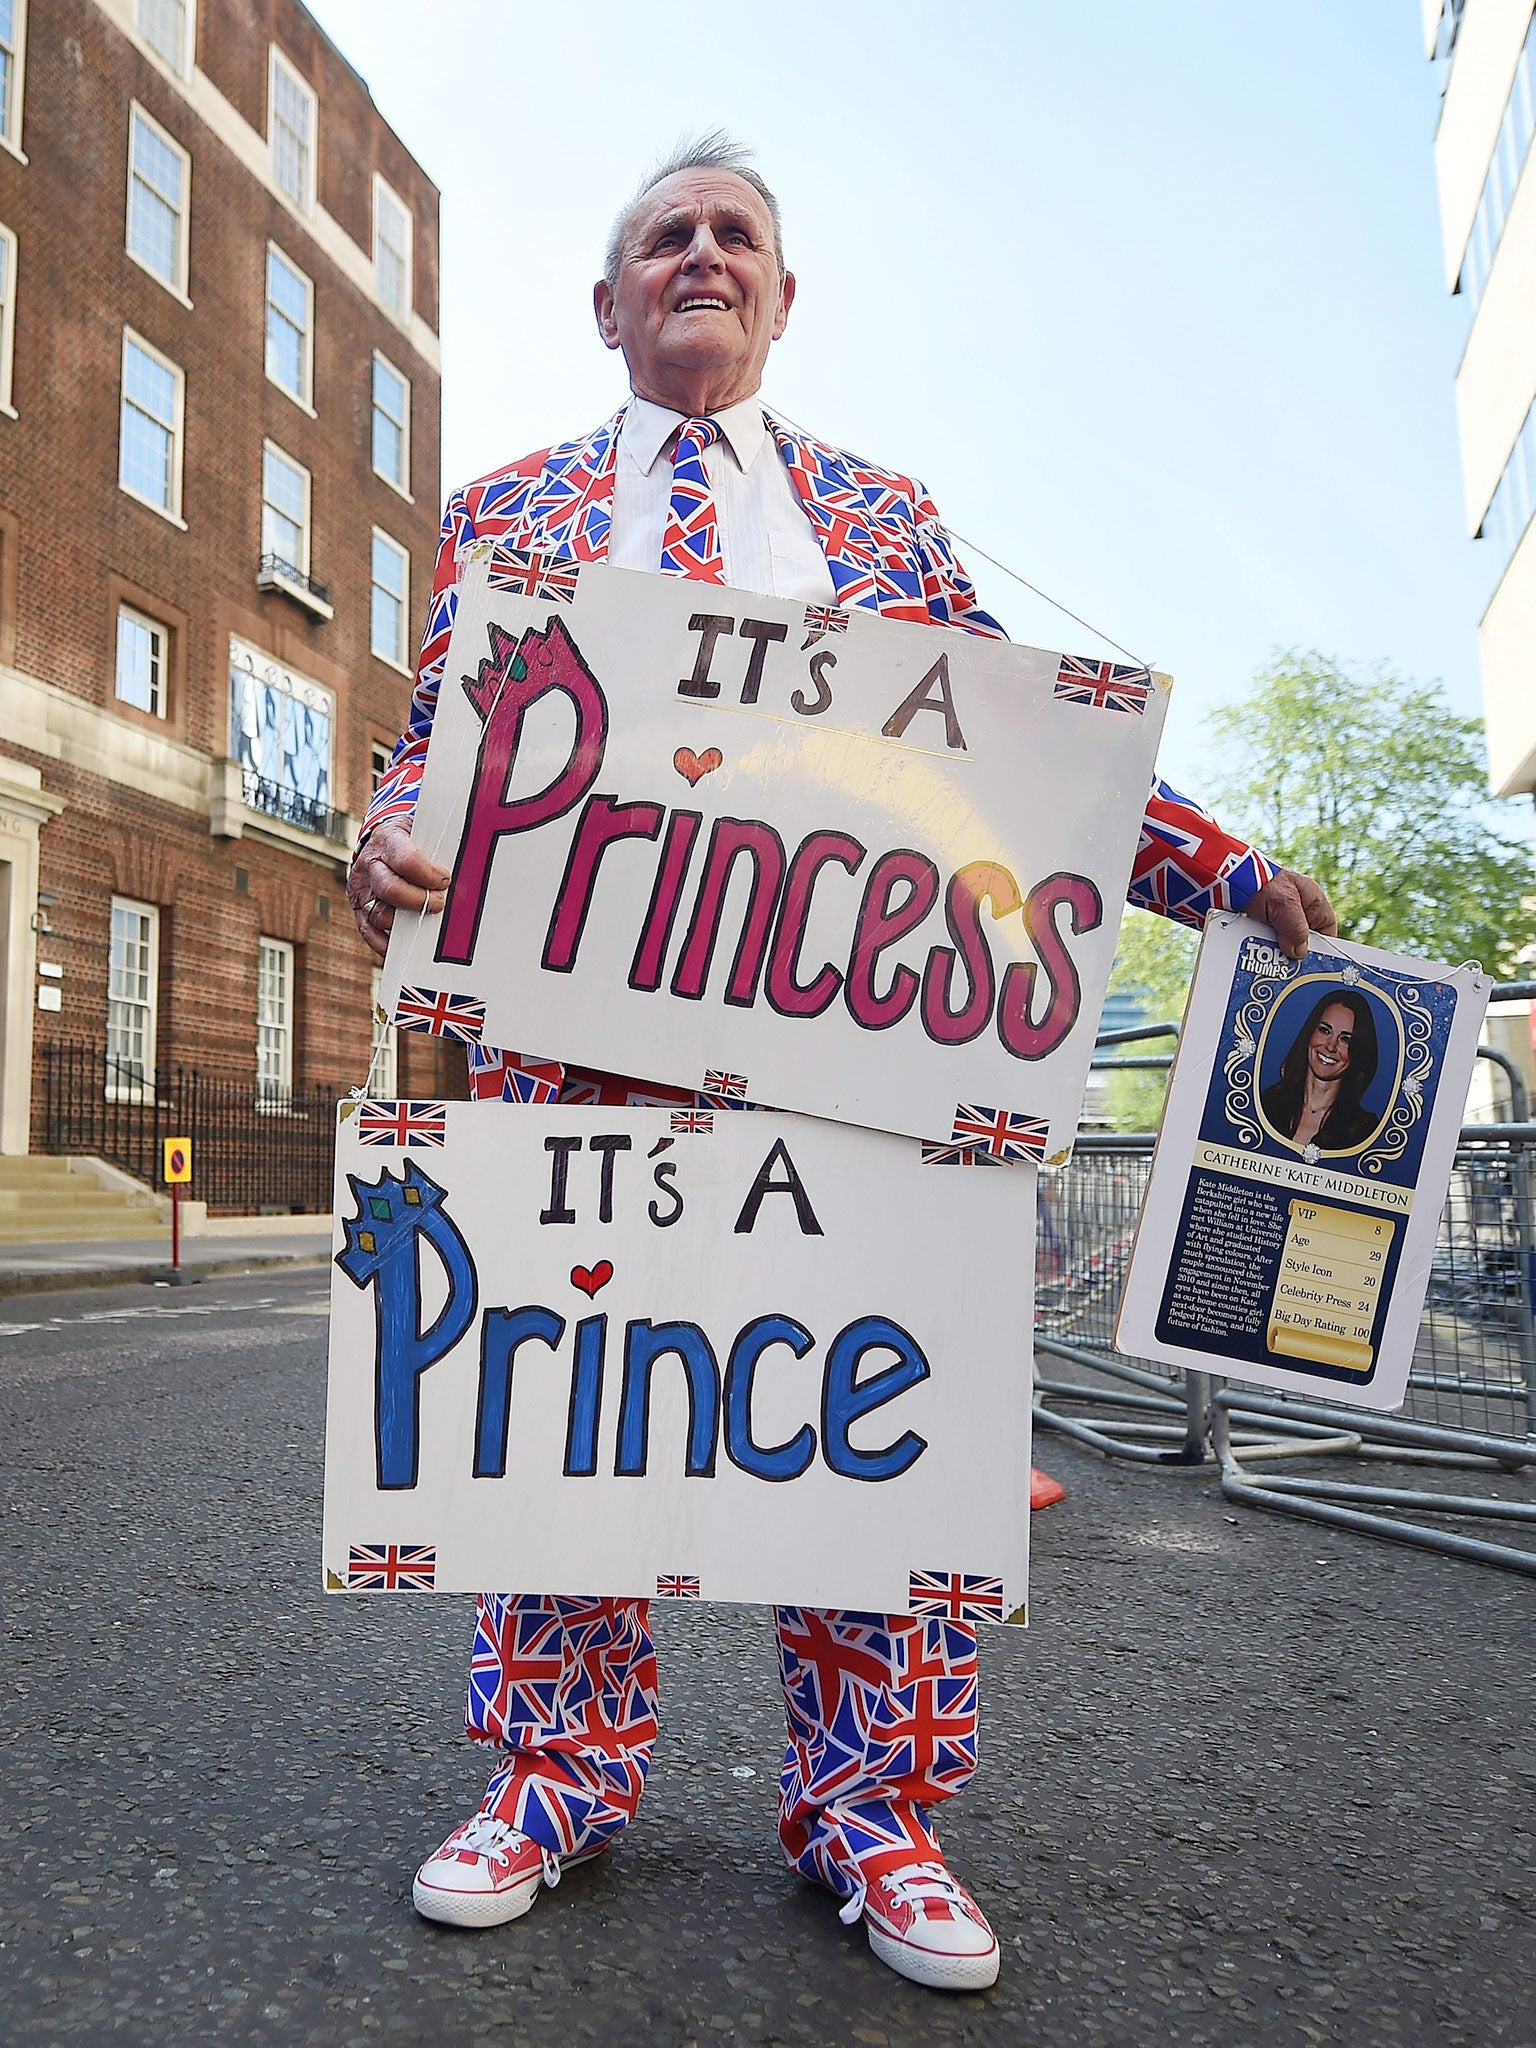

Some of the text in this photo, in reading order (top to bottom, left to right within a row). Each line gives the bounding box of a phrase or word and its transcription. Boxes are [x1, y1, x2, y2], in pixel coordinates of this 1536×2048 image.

[881, 652, 968, 750] A
[433, 614, 1101, 1061] Princess
[1241, 955, 1289, 980] TRUMPS
[734, 1137, 825, 1236] A
[1198, 1178, 1275, 1201] Kate Middleton is the
[1203, 1150, 1282, 1178] CATHERINE
[1325, 1178, 1409, 1207] MIDDLETON
[1196, 1187, 1232, 1201] Berkshire
[1232, 1195, 1246, 1204] girl
[1247, 1199, 1262, 1208] who
[1190, 1214, 1204, 1222] met
[1207, 1216, 1234, 1229] William
[1193, 1205, 1212, 1215] when
[1213, 1209, 1226, 1218] she
[1227, 1212, 1240, 1221] fell
[1240, 1214, 1248, 1223] in
[1267, 1220, 1281, 1230] She
[1233, 1204, 1248, 1213] into
[1271, 1212, 1283, 1221] life
[1298, 1207, 1382, 1235] VIP 8
[1189, 1222, 1281, 1249] where she studied History
[1195, 1232, 1207, 1241] Art
[1223, 1240, 1261, 1253] graduated
[1291, 1233, 1381, 1262] Age 29
[1182, 1249, 1203, 1258] much
[1248, 1262, 1260, 1271] the
[1185, 1240, 1201, 1248] with
[1202, 1242, 1224, 1255] flying
[1253, 1254, 1273, 1264] After
[1180, 1257, 1263, 1280] couple announced their
[1285, 1258, 1376, 1286] Style Icon 20
[1177, 1273, 1195, 1283] 2010
[1195, 1279, 1210, 1287] and
[1211, 1281, 1229, 1291] since
[1250, 1290, 1260, 1298] all
[1223, 1274, 1231, 1282] in
[1232, 1276, 1270, 1290] November
[1182, 1294, 1195, 1302] our
[1196, 1295, 1217, 1306] home
[1217, 1302, 1248, 1313] counties
[1192, 1285, 1209, 1296] have
[1210, 1289, 1228, 1300] been
[1240, 1296, 1257, 1306] Kate
[1280, 1284, 1370, 1312] Celebrity Press 24
[1167, 1316, 1190, 1328] future
[1169, 1308, 1195, 1320] fledged
[1245, 1325, 1257, 1333] the
[1171, 1301, 1206, 1313] next-door
[1207, 1307, 1237, 1320] becomes
[1244, 1315, 1261, 1326] fully
[1274, 1309, 1370, 1338] Big Day Rating 100
[342, 1162, 931, 1491] Prince
